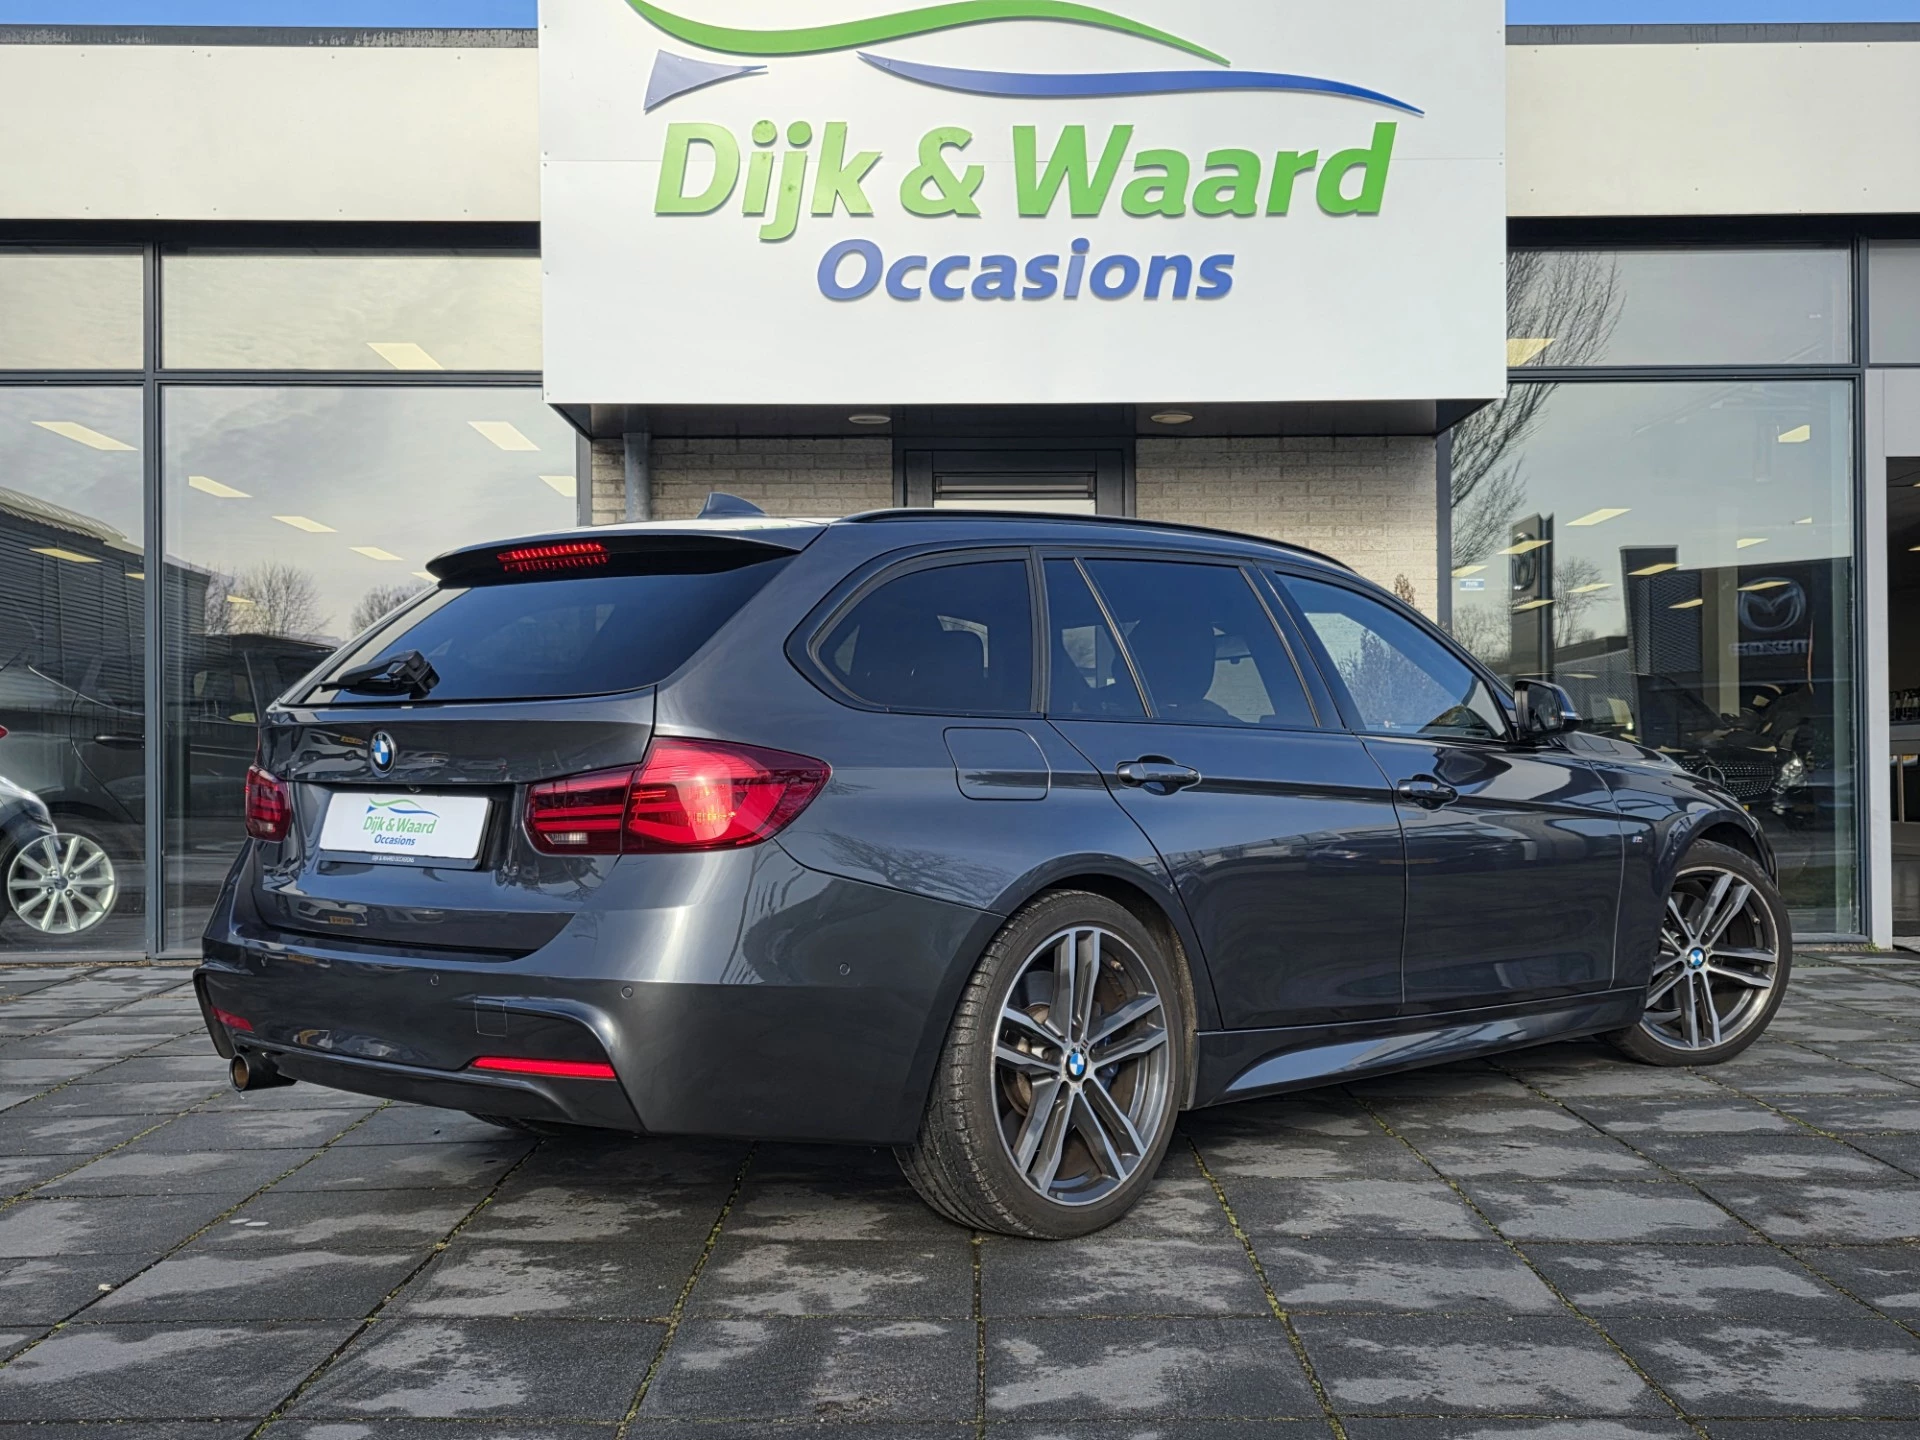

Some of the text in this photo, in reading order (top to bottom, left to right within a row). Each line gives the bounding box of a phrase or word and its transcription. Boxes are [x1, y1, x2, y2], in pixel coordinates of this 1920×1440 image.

[655, 121, 1398, 240] Dijk & Waard
[817, 238, 1236, 301] Occasions
[363, 816, 438, 835] Dijk & Waard
[374, 833, 416, 846] Occasions
